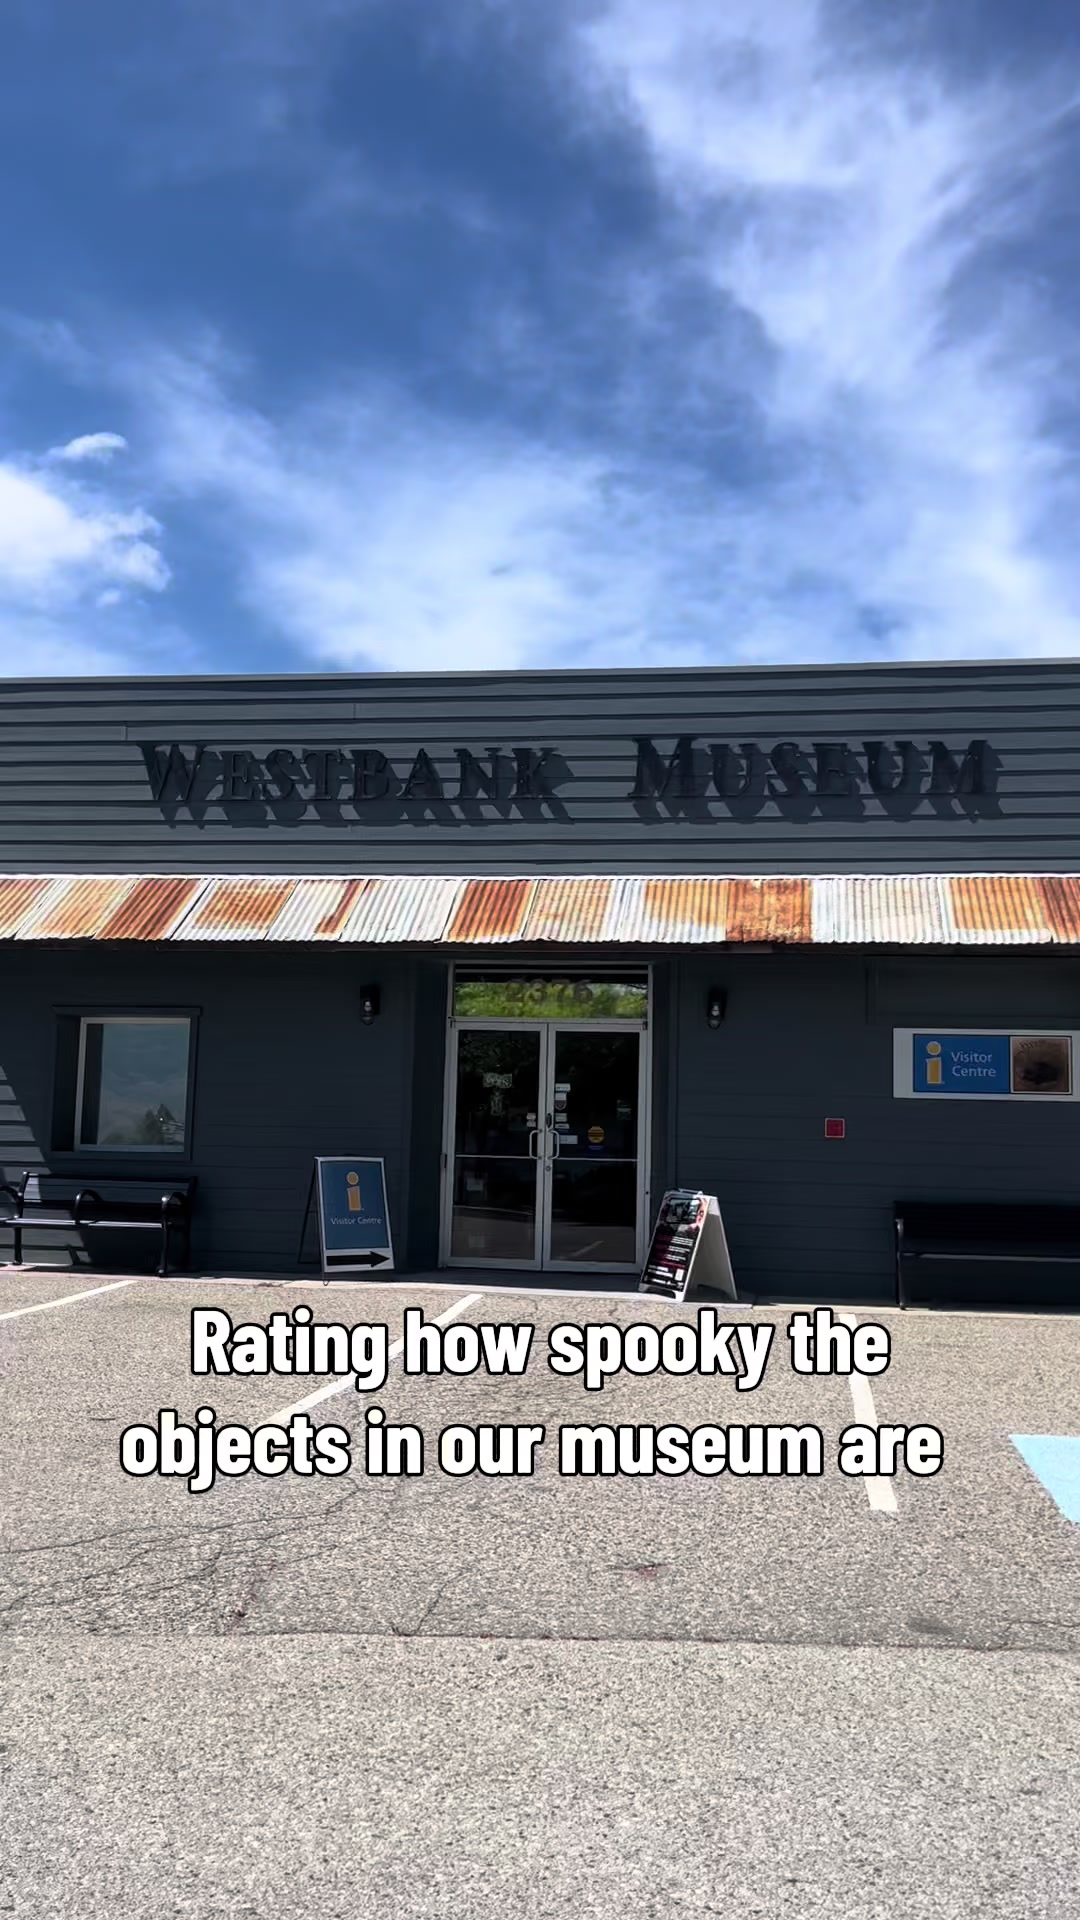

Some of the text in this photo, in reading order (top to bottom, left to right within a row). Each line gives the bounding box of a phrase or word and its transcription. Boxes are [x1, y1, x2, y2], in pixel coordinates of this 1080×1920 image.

[137, 737, 989, 801] WESTBANK MUSEUM
[950, 1050, 993, 1063] Visitor
[951, 1065, 997, 1077] Centre
[330, 1216, 382, 1225] Visitor Centre
